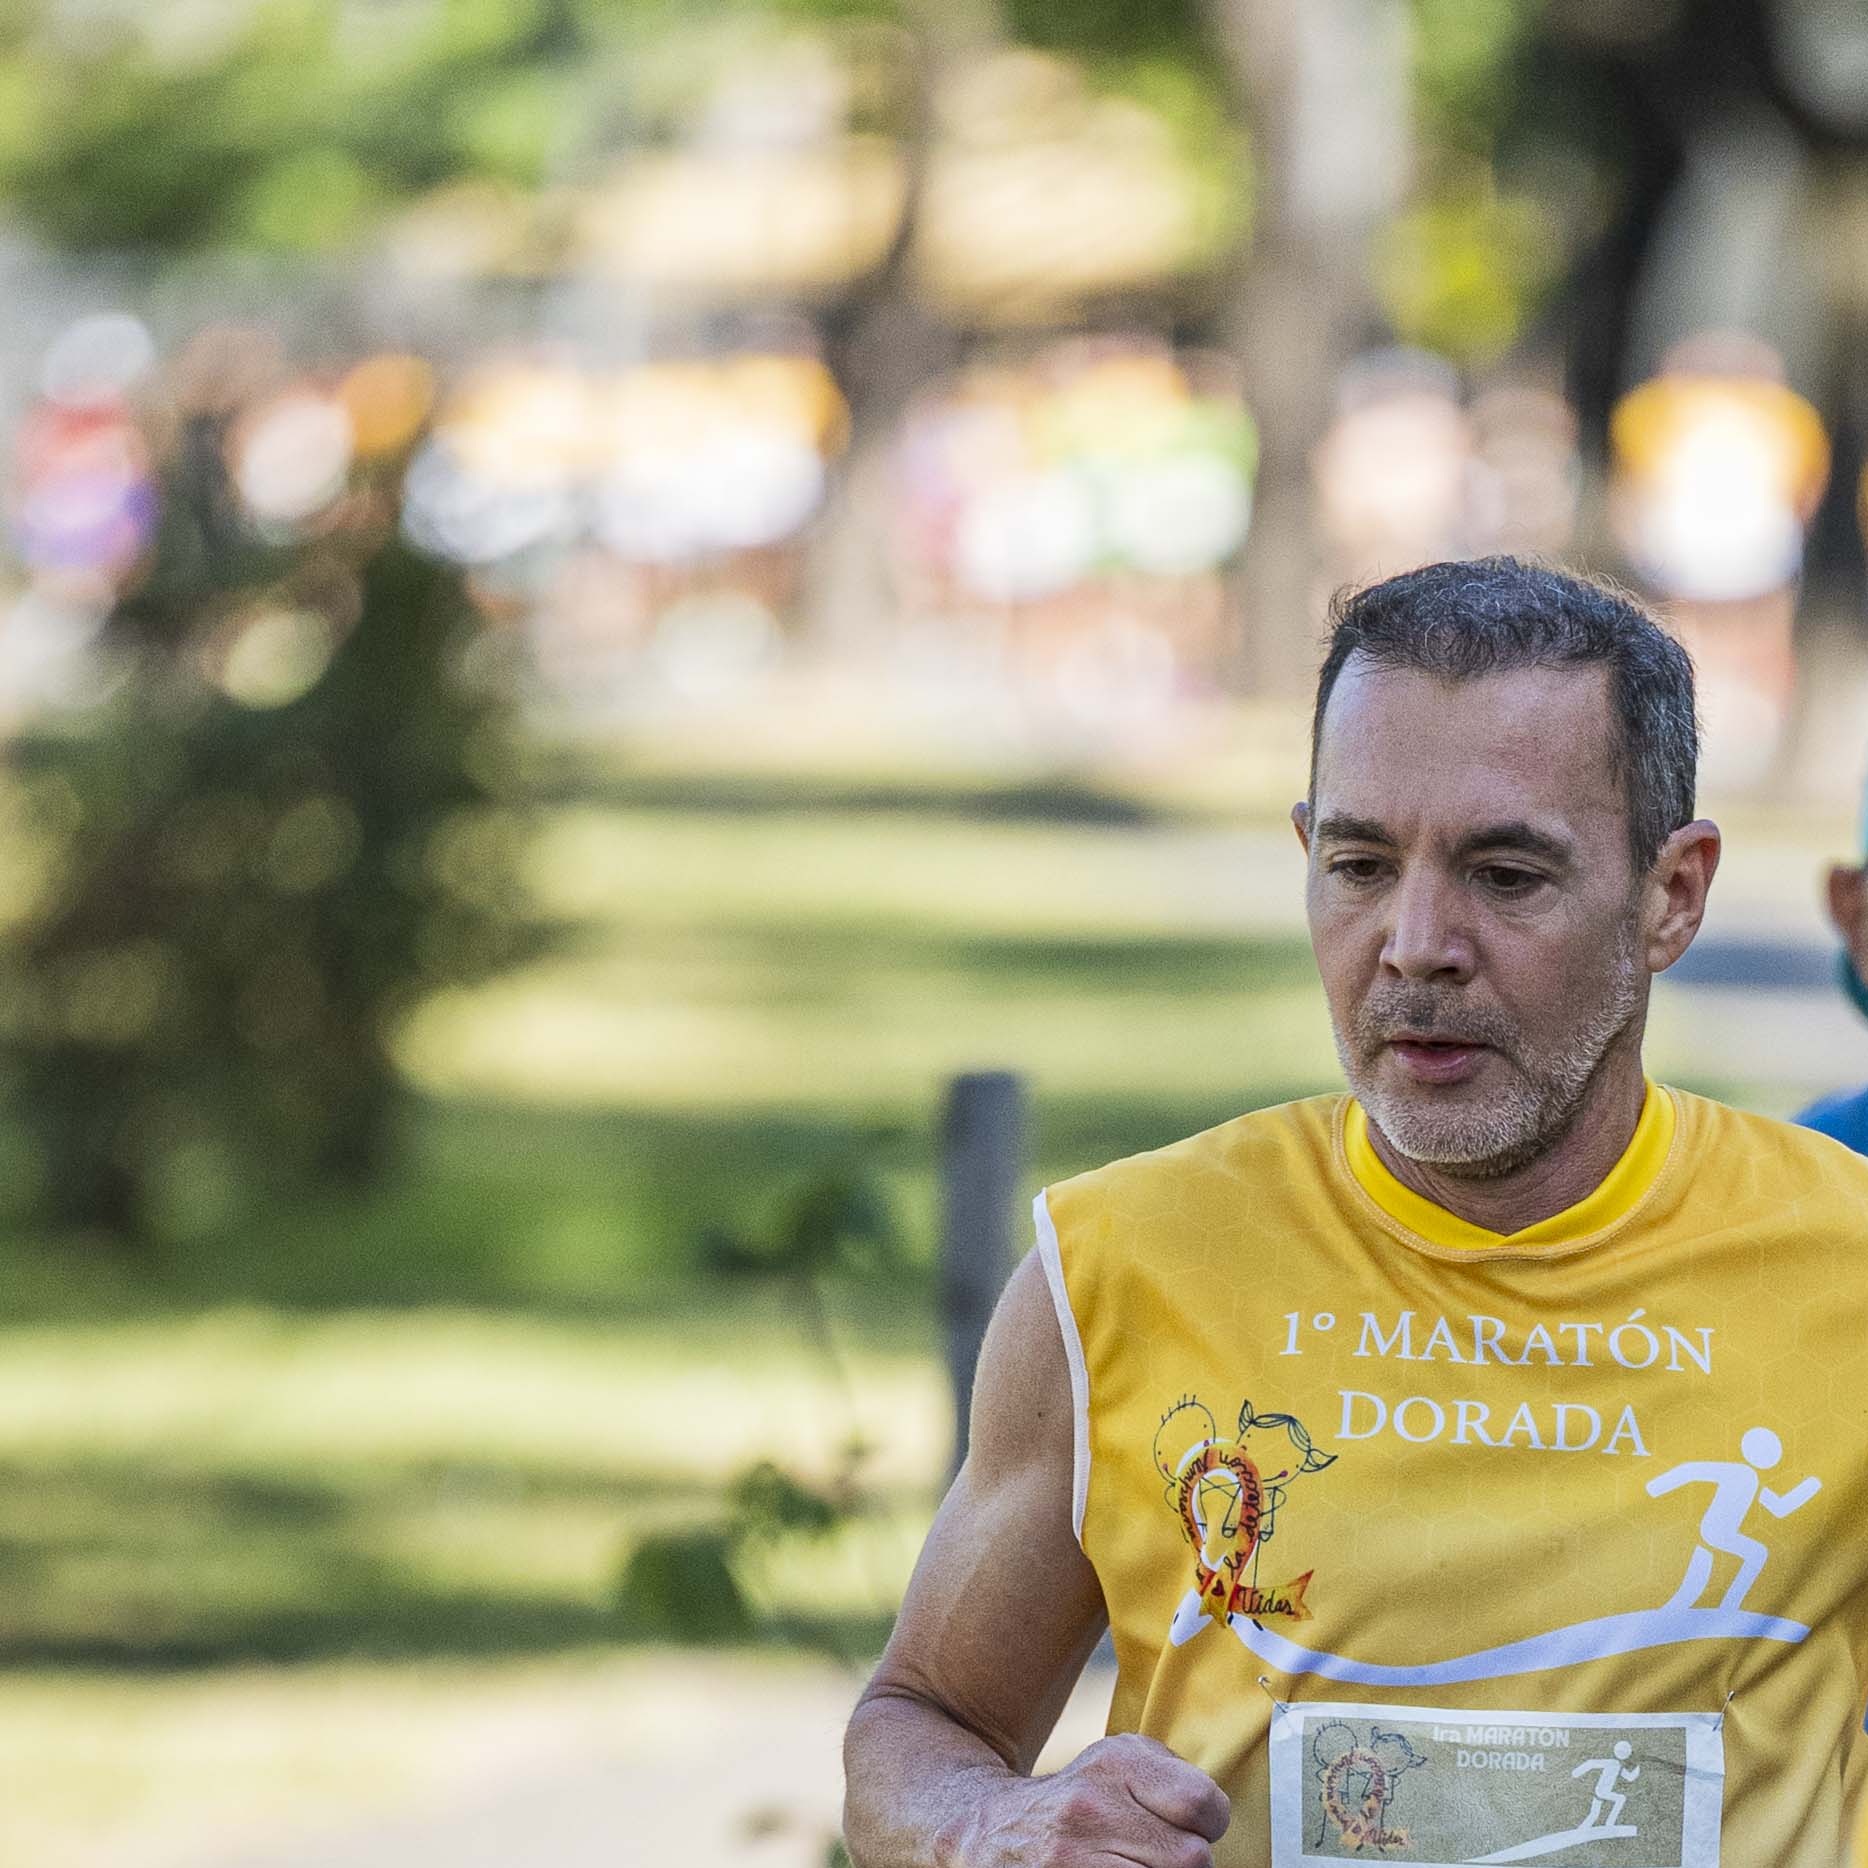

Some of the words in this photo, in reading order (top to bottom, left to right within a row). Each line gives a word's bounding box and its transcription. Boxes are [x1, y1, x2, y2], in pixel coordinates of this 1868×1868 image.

[1352, 1307, 1716, 1375] MARATÓN
[1334, 1389, 1653, 1457] DORADA
[1455, 1750, 1545, 1770] DORADA
